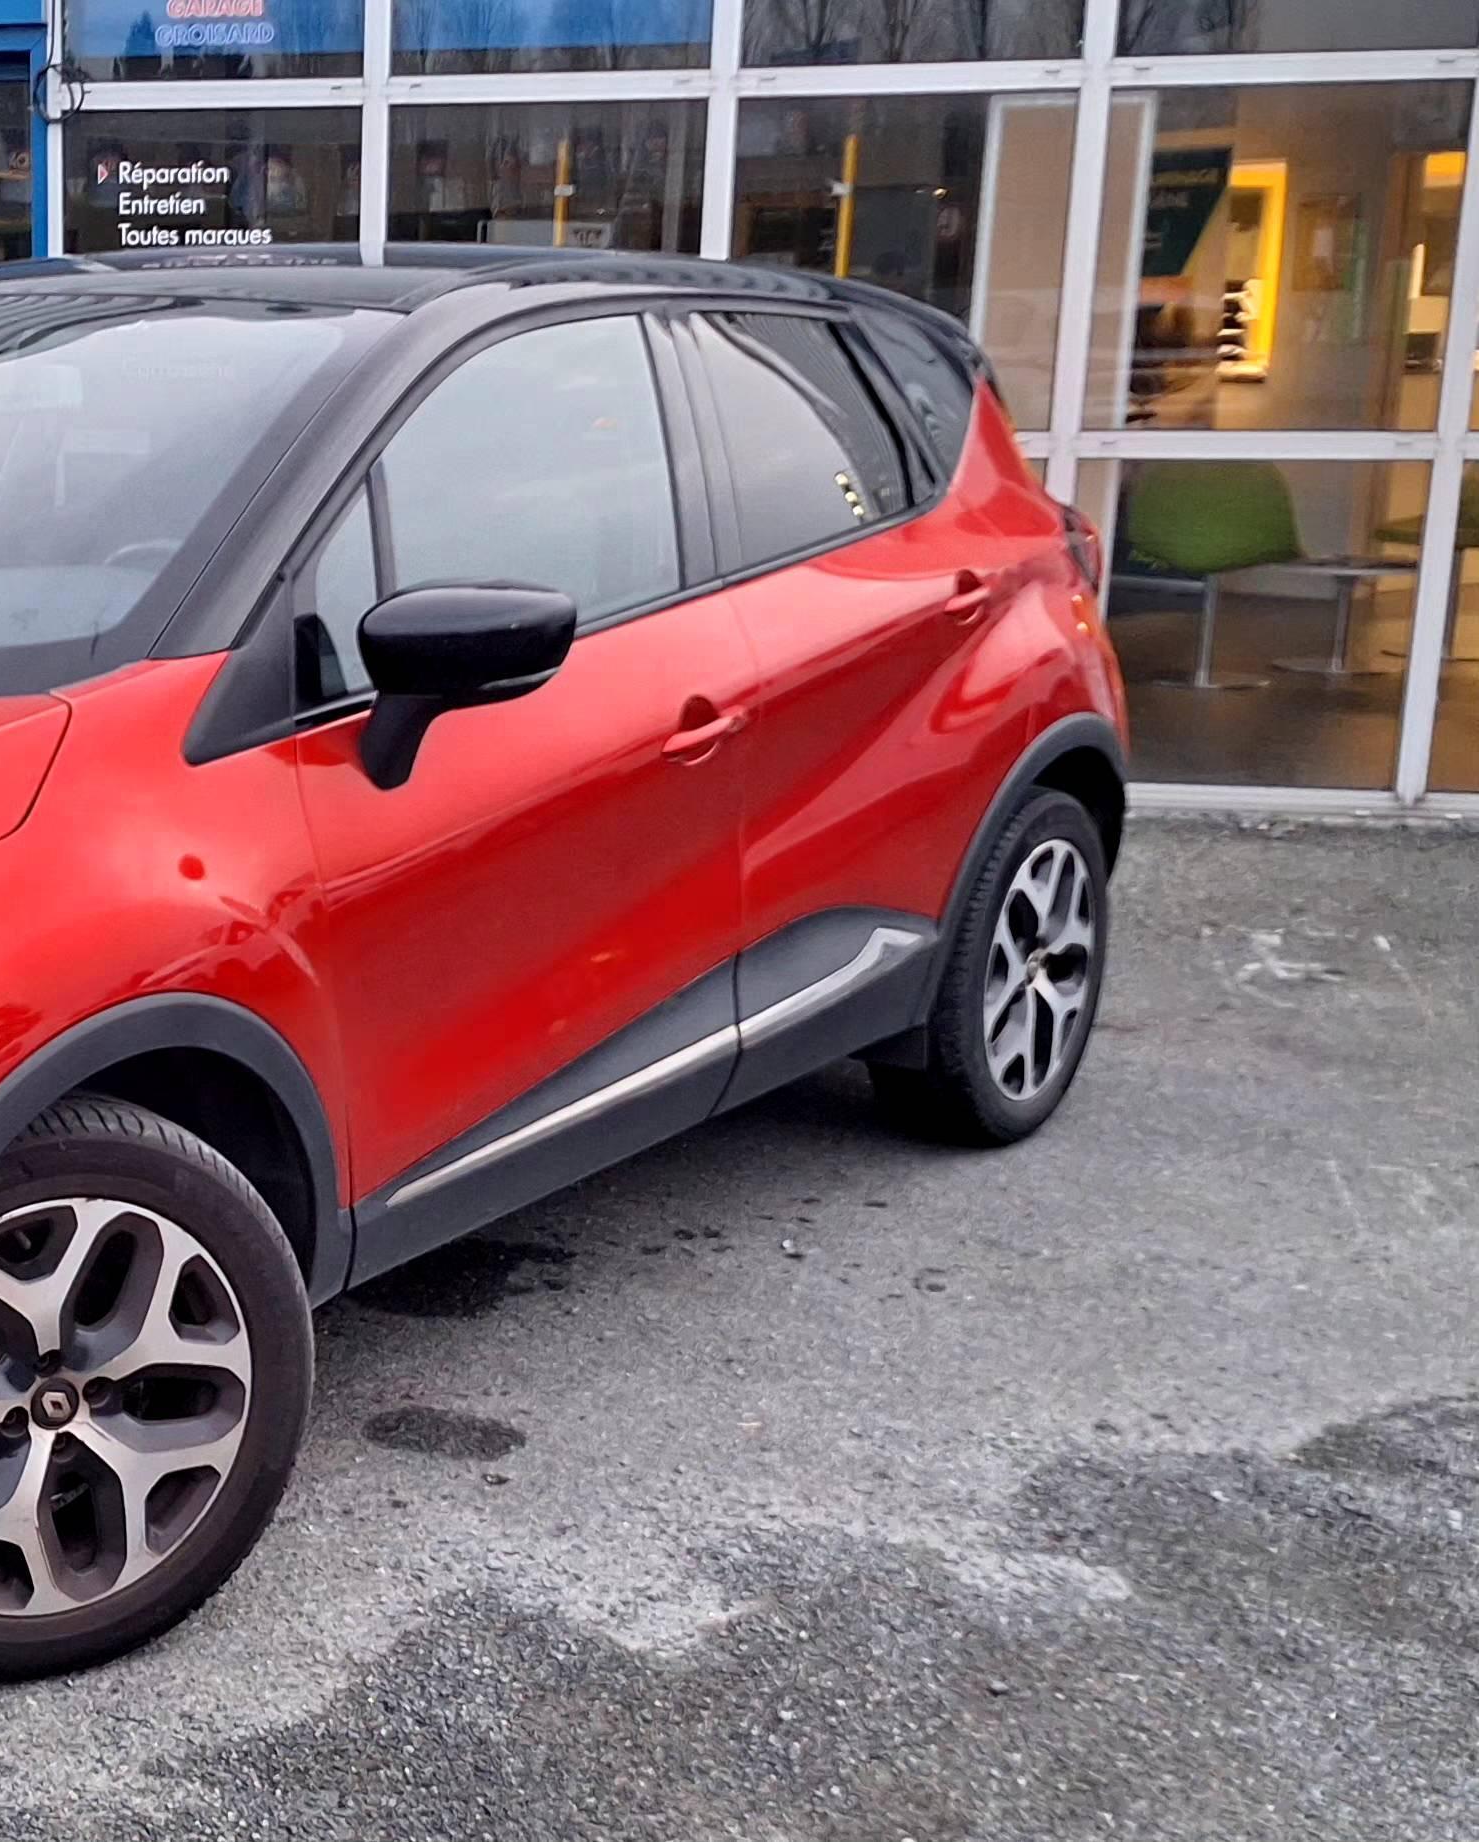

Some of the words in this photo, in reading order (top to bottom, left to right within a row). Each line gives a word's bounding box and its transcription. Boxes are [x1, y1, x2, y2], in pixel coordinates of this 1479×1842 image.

[166, 0, 264, 17] GARAGE
[119, 160, 229, 191] Réparation
[119, 192, 205, 215] Entretien
[118, 223, 179, 246] Toutes
[185, 228, 272, 246] marques
